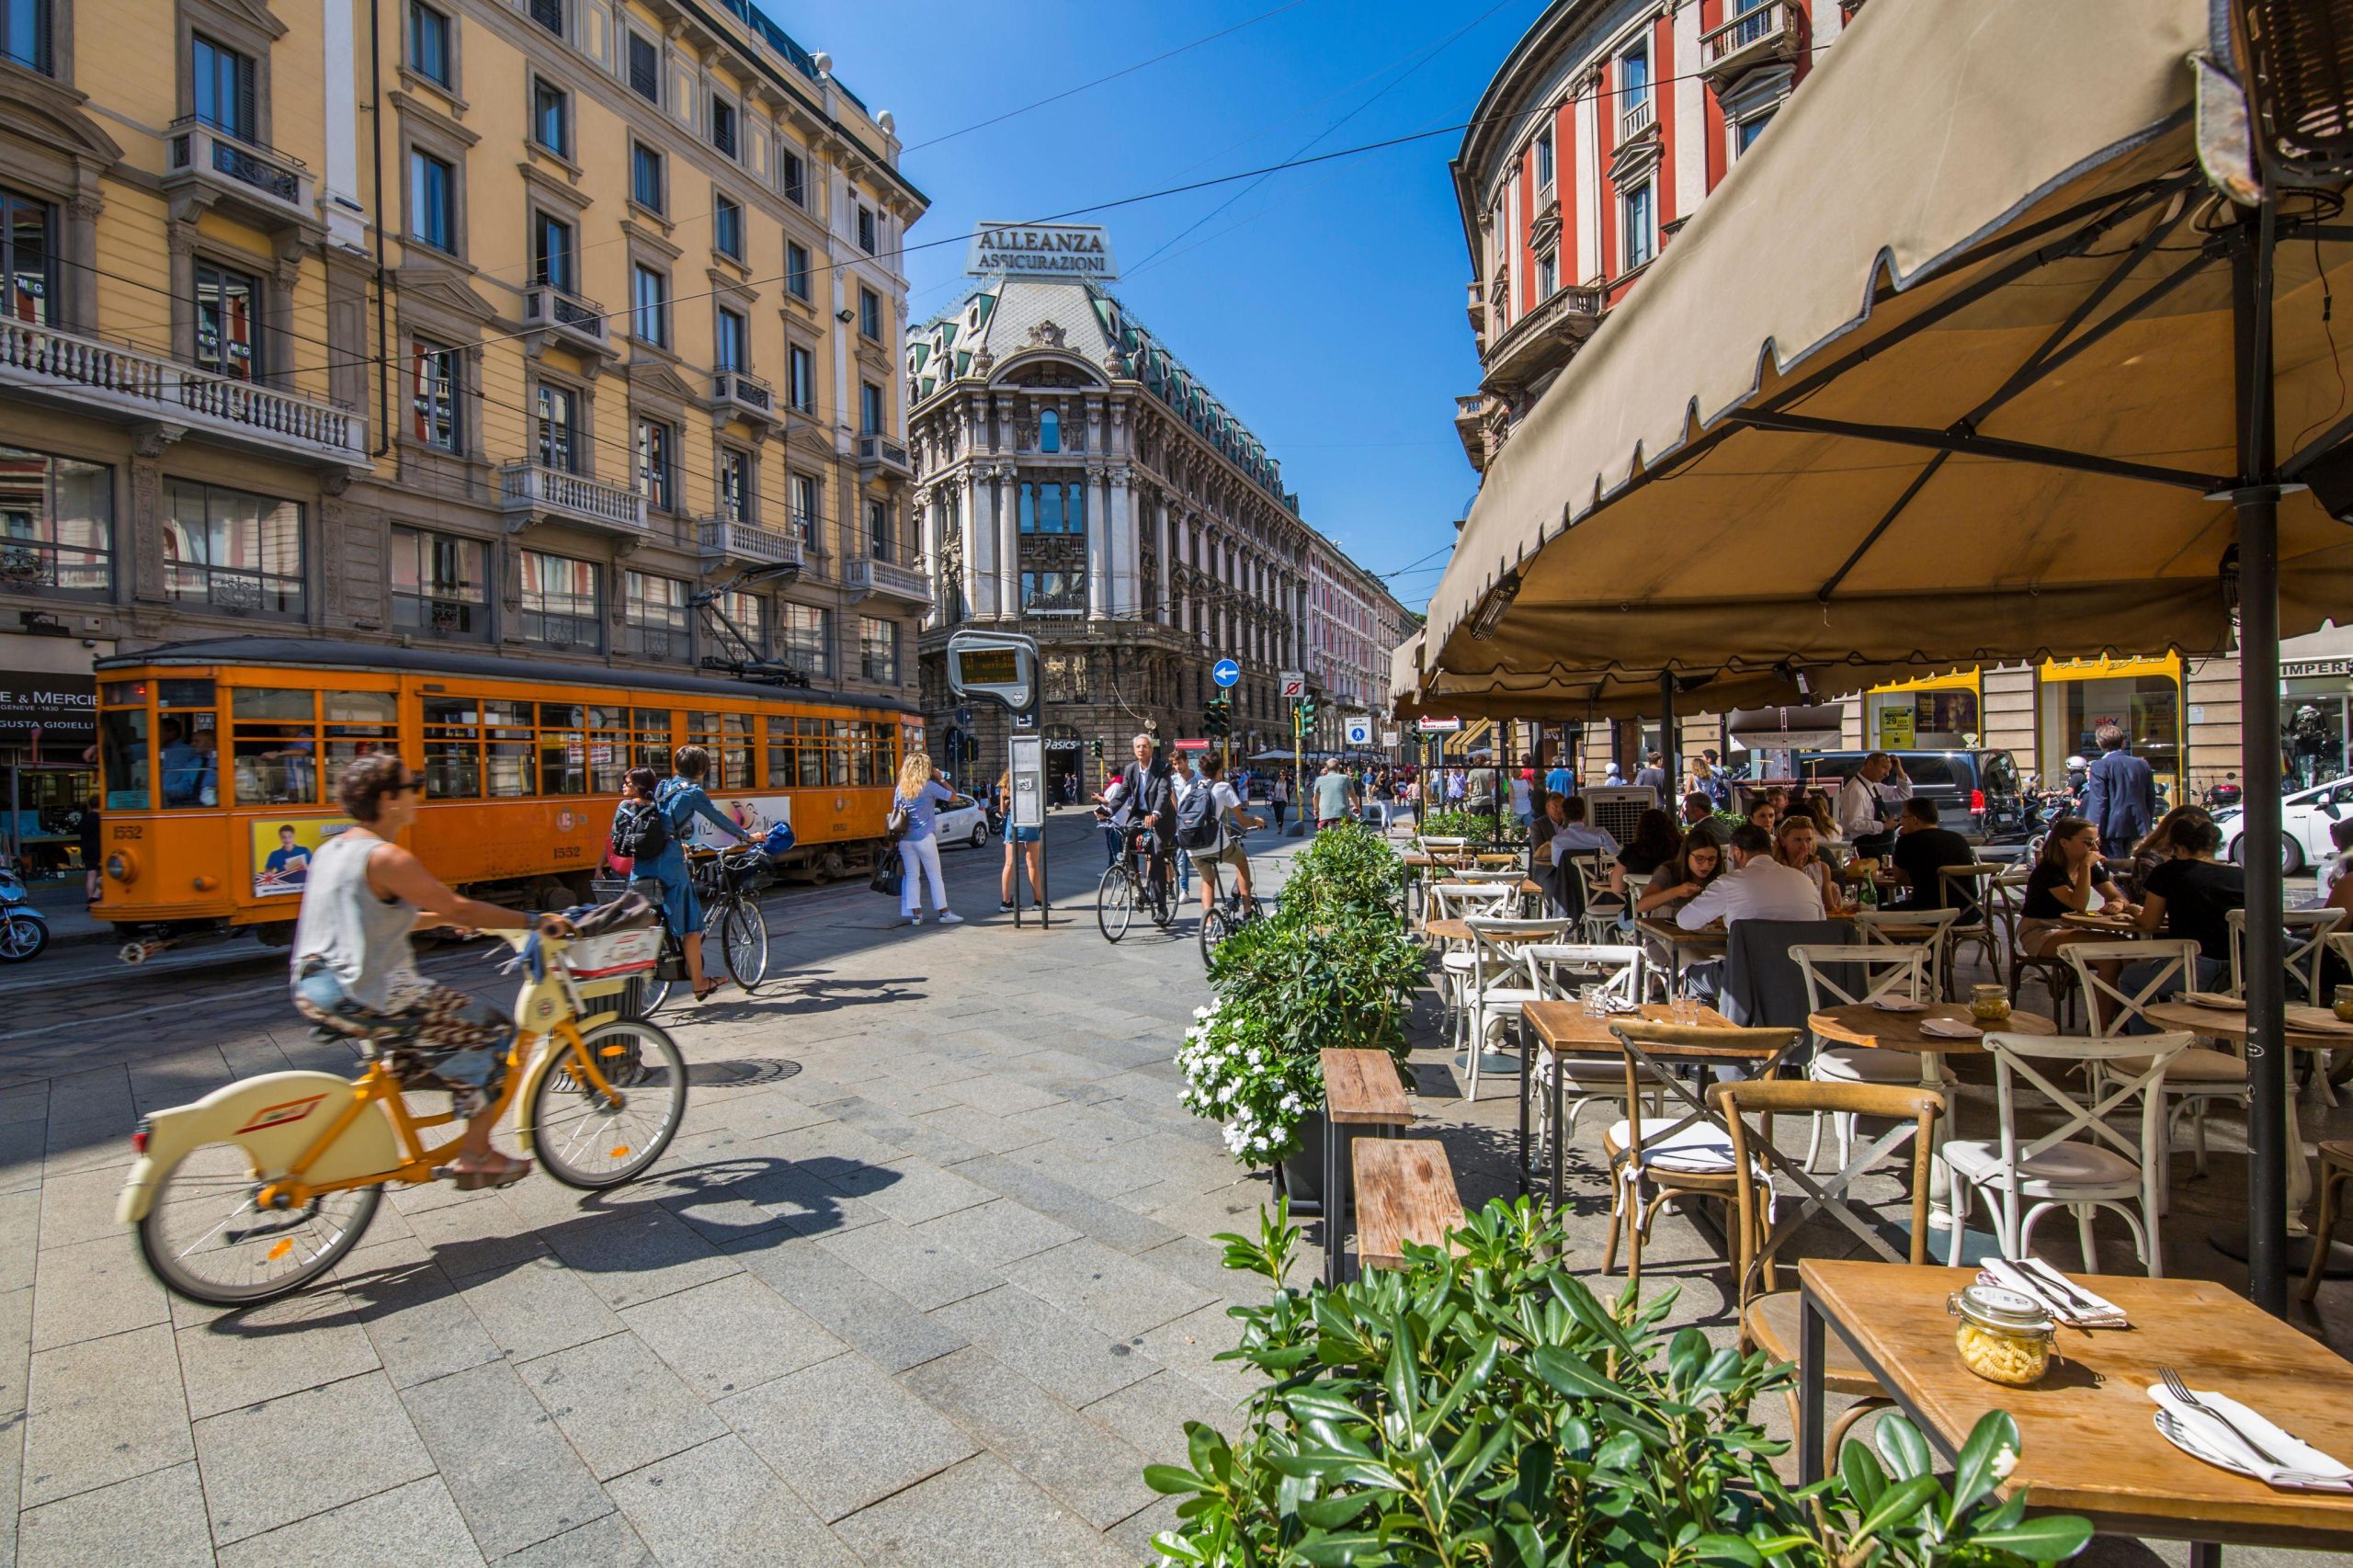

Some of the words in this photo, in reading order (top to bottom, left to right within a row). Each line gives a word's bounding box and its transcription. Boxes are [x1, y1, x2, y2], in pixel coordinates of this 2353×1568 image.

[978, 230, 1105, 253] ALLEANZA
[978, 254, 1106, 271] ASSICURAZIONI
[18, 278, 43, 293] M&G
[2282, 662, 2353, 676] IMPER
[44, 721, 94, 730] GIOIELLI
[2096, 716, 2120, 726] sky
[1051, 740, 1076, 750] asics
[113, 825, 143, 840] 1552
[553, 846, 581, 859] 1552
